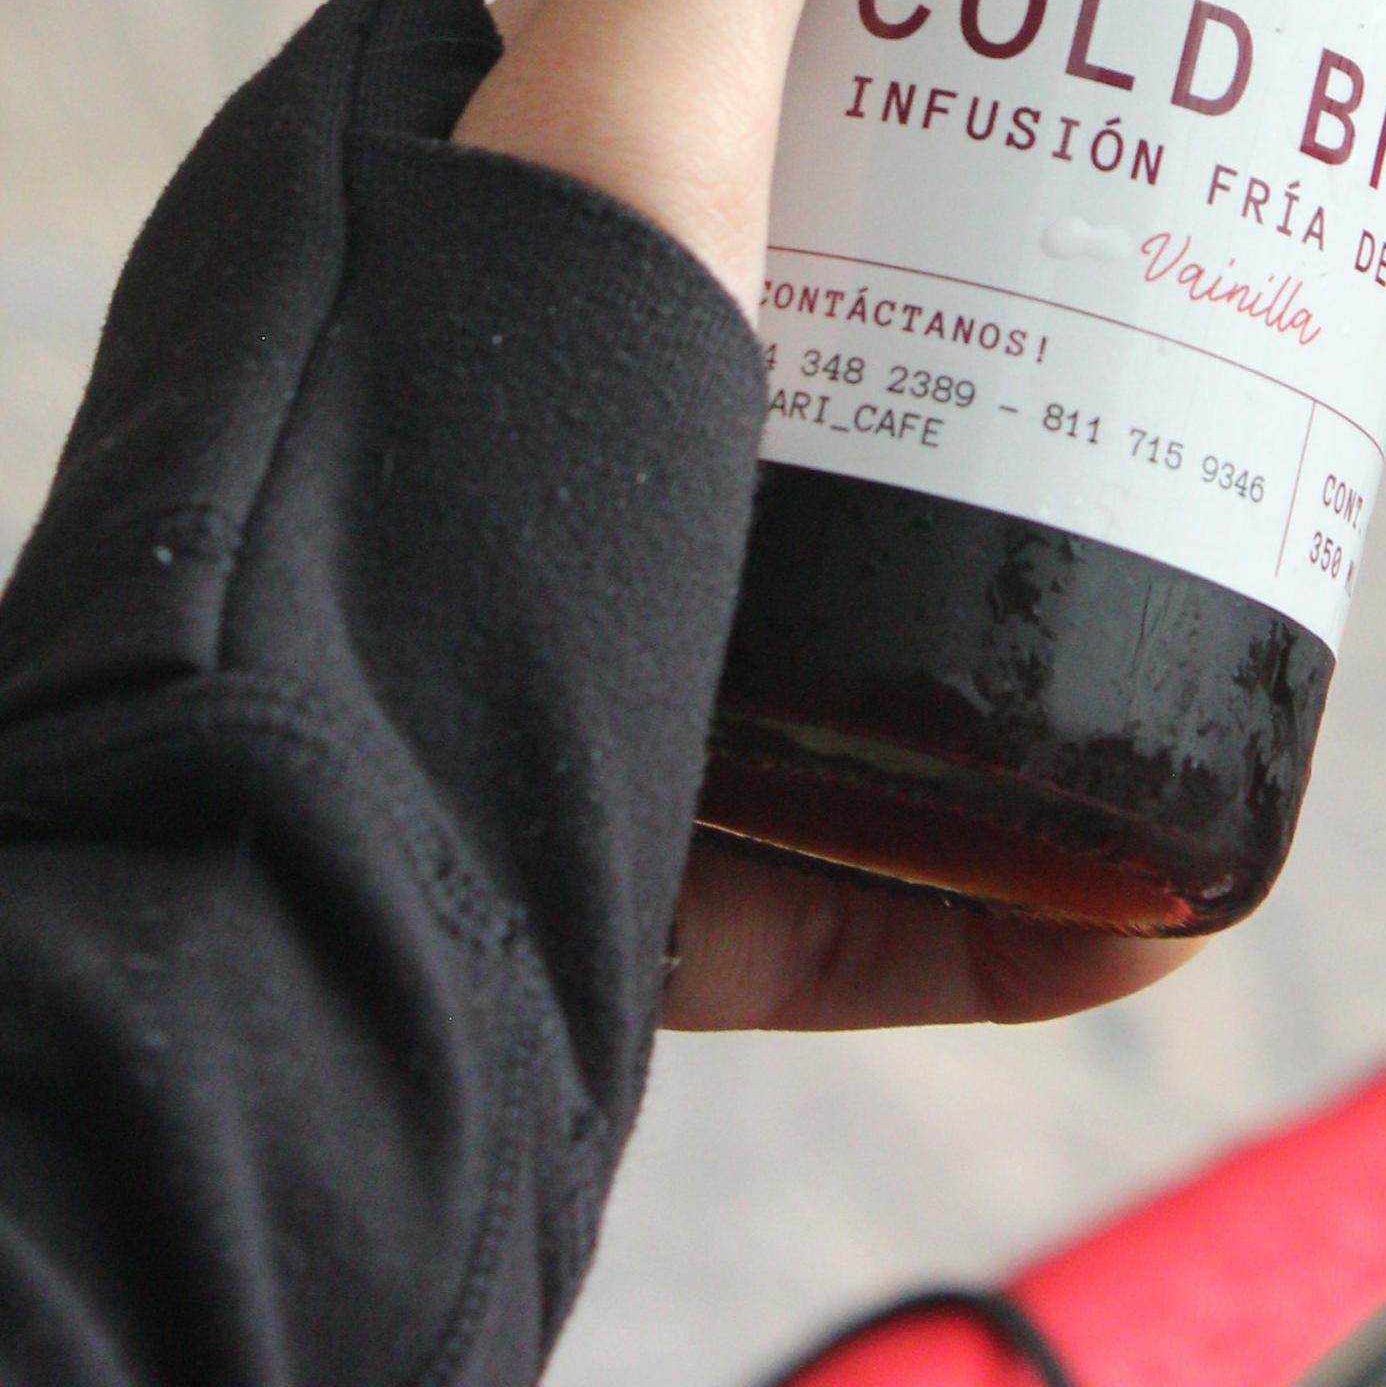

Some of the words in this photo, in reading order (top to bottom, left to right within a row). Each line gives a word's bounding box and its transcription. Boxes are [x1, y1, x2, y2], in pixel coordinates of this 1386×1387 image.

[844, 74, 1165, 187] INFUSIÓN
[1206, 158, 1325, 252] FRÍA
[1140, 231, 1322, 346] Vainilla
[761, 343, 778, 372] 4
[800, 348, 866, 385] 348
[886, 365, 977, 409] 2389
[1042, 402, 1101, 446] 811
[1130, 428, 1185, 471] 715
[1202, 454, 1266, 504] 9346
[768, 388, 945, 449] ARI_CAFE
[1309, 530, 1343, 579] 350
